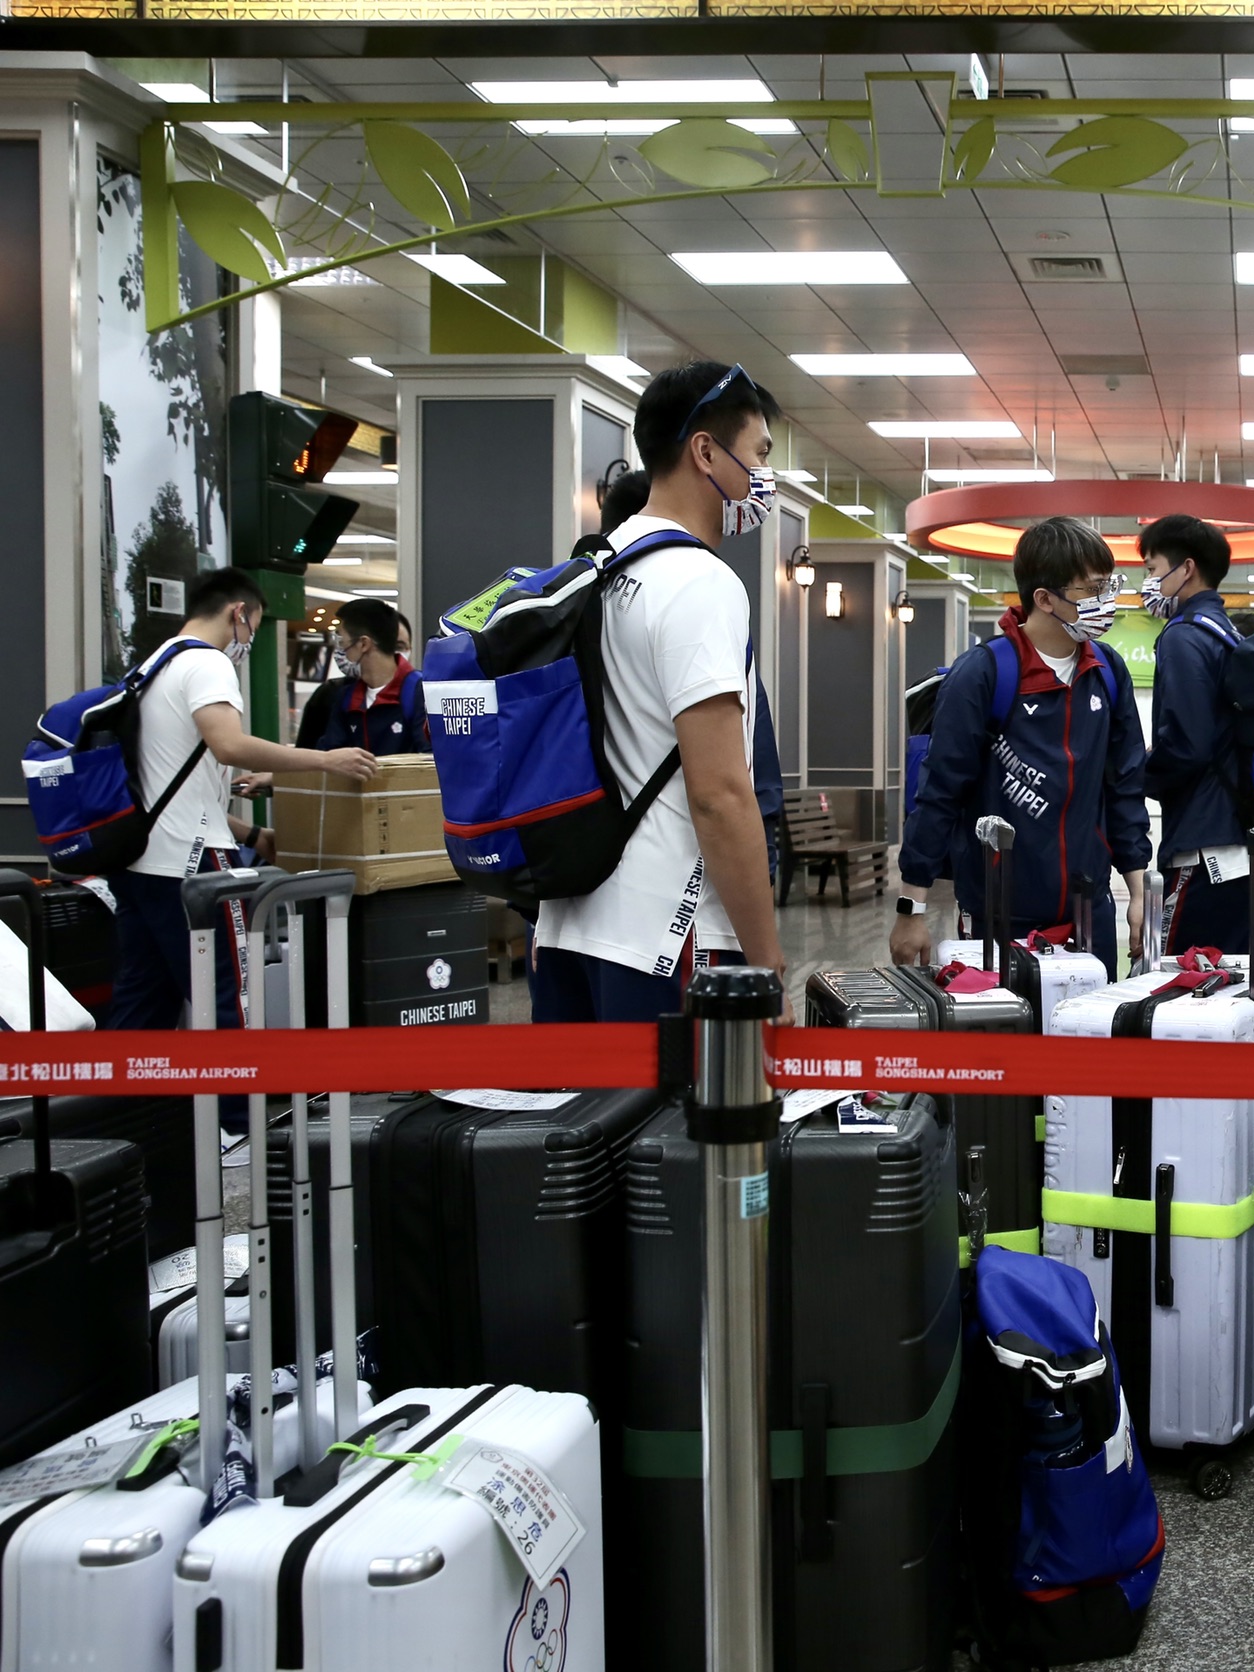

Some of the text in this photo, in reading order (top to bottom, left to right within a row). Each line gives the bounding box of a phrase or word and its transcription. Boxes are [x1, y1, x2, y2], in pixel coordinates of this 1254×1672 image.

[441, 697, 485, 717] CHINESE
[443, 717, 471, 735] TAIPEI
[1001, 772, 1049, 820] TAIPEI
[669, 899, 697, 937] TAIPEI
[400, 999, 476, 1026] CHINESE TAIPEI
[127, 1057, 170, 1068] TAIPEI
[875, 1056, 918, 1068] TAIPEI
[127, 1067, 258, 1079] SONGSHAN AIRPORT
[875, 1067, 1005, 1081] SONGSHAN AIRPORT
